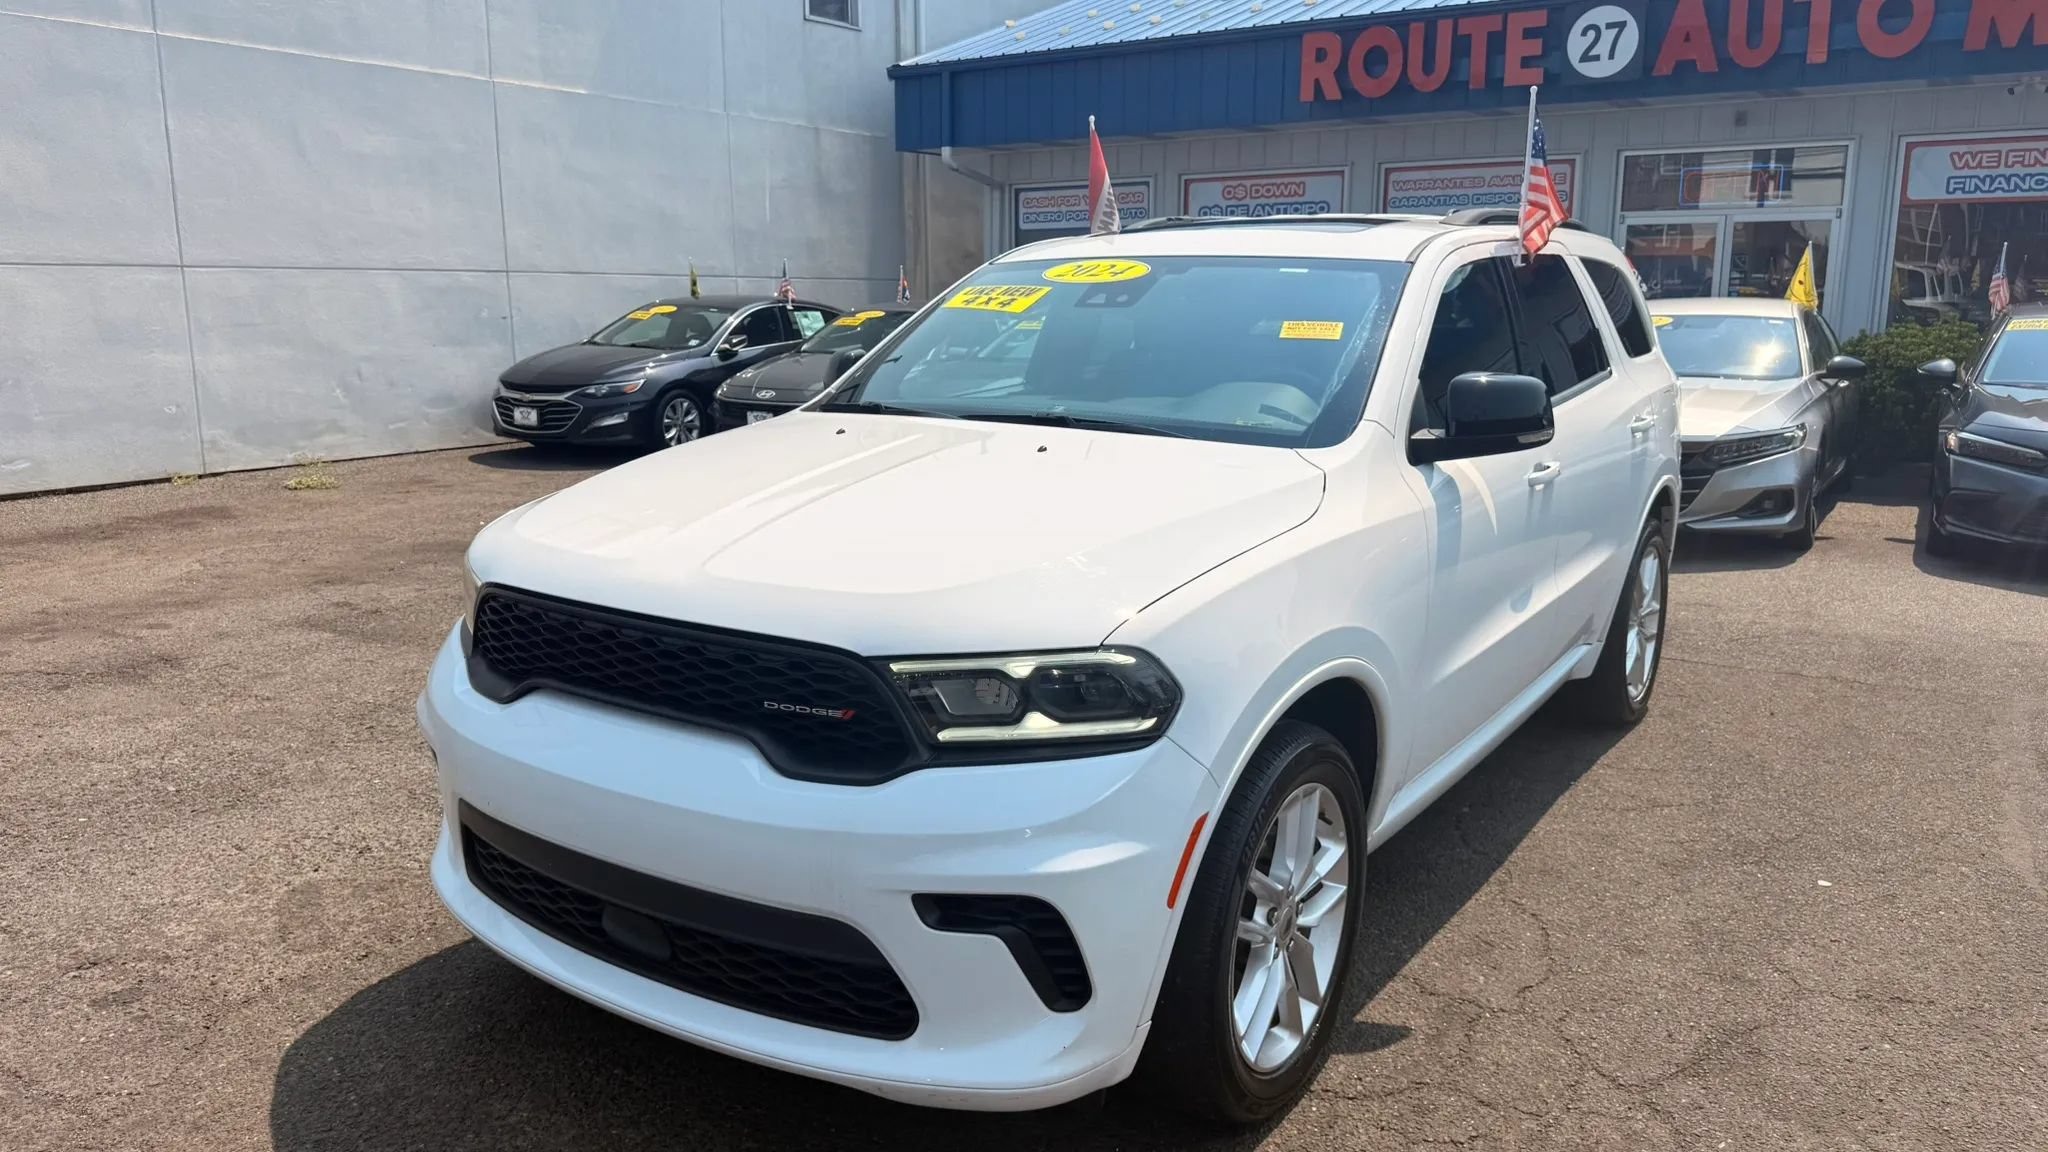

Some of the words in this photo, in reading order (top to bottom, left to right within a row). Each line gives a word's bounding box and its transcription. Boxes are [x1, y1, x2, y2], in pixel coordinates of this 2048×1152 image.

[1300, 9, 1548, 102] ROUTE
[1578, 20, 1628, 64] 27
[1652, 0, 1936, 76] AUTO
[1950, 150, 2001, 171] WE
[1250, 182, 1305, 199] DOWN
[1392, 177, 1484, 192] WARRANTIES
[1023, 197, 1056, 209] CASH
[1056, 195, 1081, 208] FOR
[1118, 192, 1145, 204] CAR
[1389, 194, 1470, 208] GARANTIAS
[1226, 204, 1250, 217] DE
[1250, 201, 1330, 217] ANTICIPO
[1023, 211, 1063, 224] DINERO
[1053, 264, 1140, 278] 2024
[996, 286, 1045, 298] NEW
[763, 701, 844, 718] DODGE
